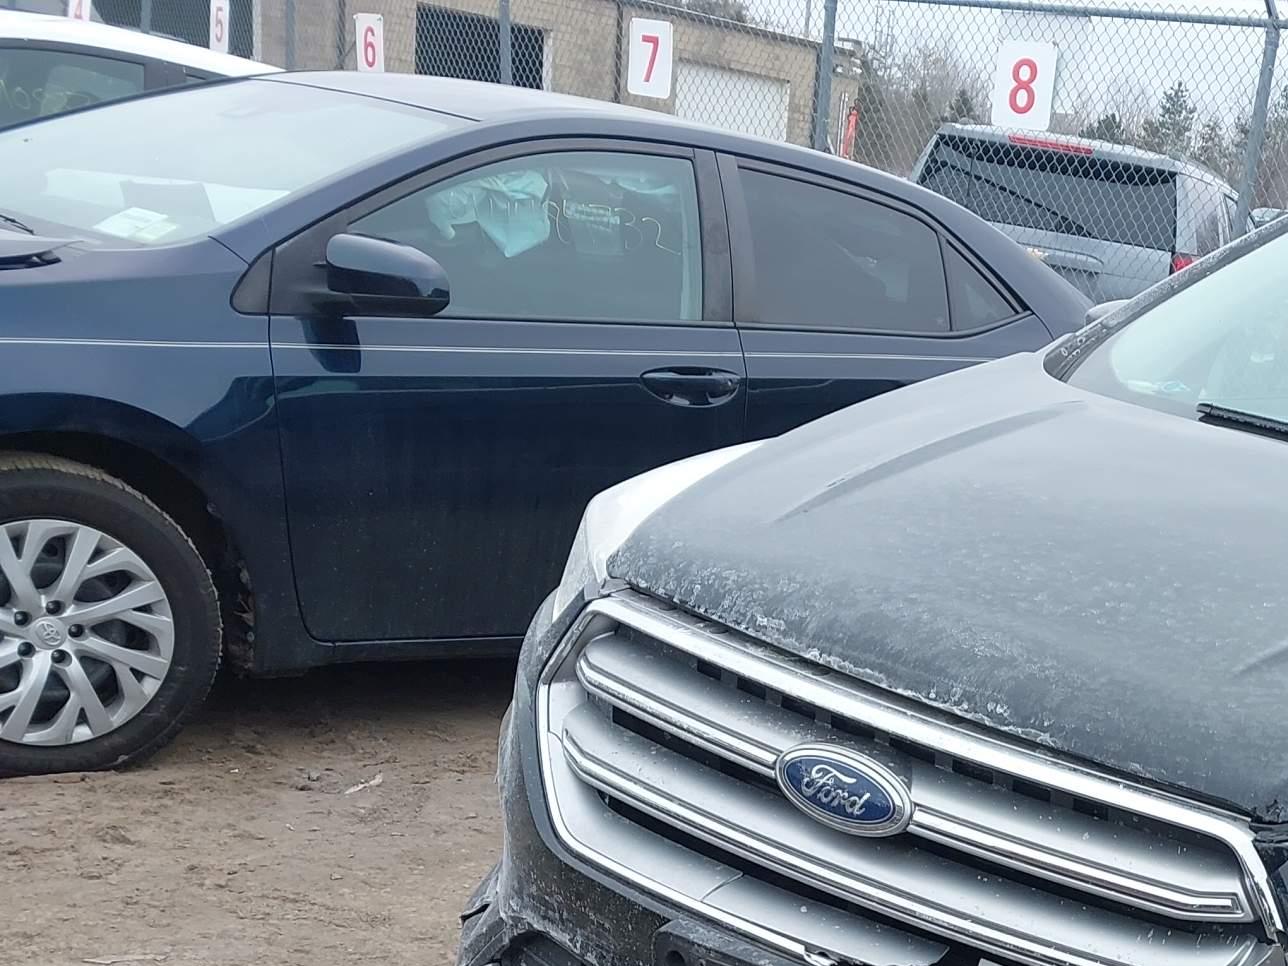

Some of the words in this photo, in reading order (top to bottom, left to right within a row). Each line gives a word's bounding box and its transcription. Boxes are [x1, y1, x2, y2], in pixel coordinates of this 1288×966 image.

[214, 6, 225, 43] 5
[362, 27, 378, 68] 6
[641, 34, 661, 83] 7
[1008, 58, 1039, 114] 8
[800, 764, 871, 816] Ford
